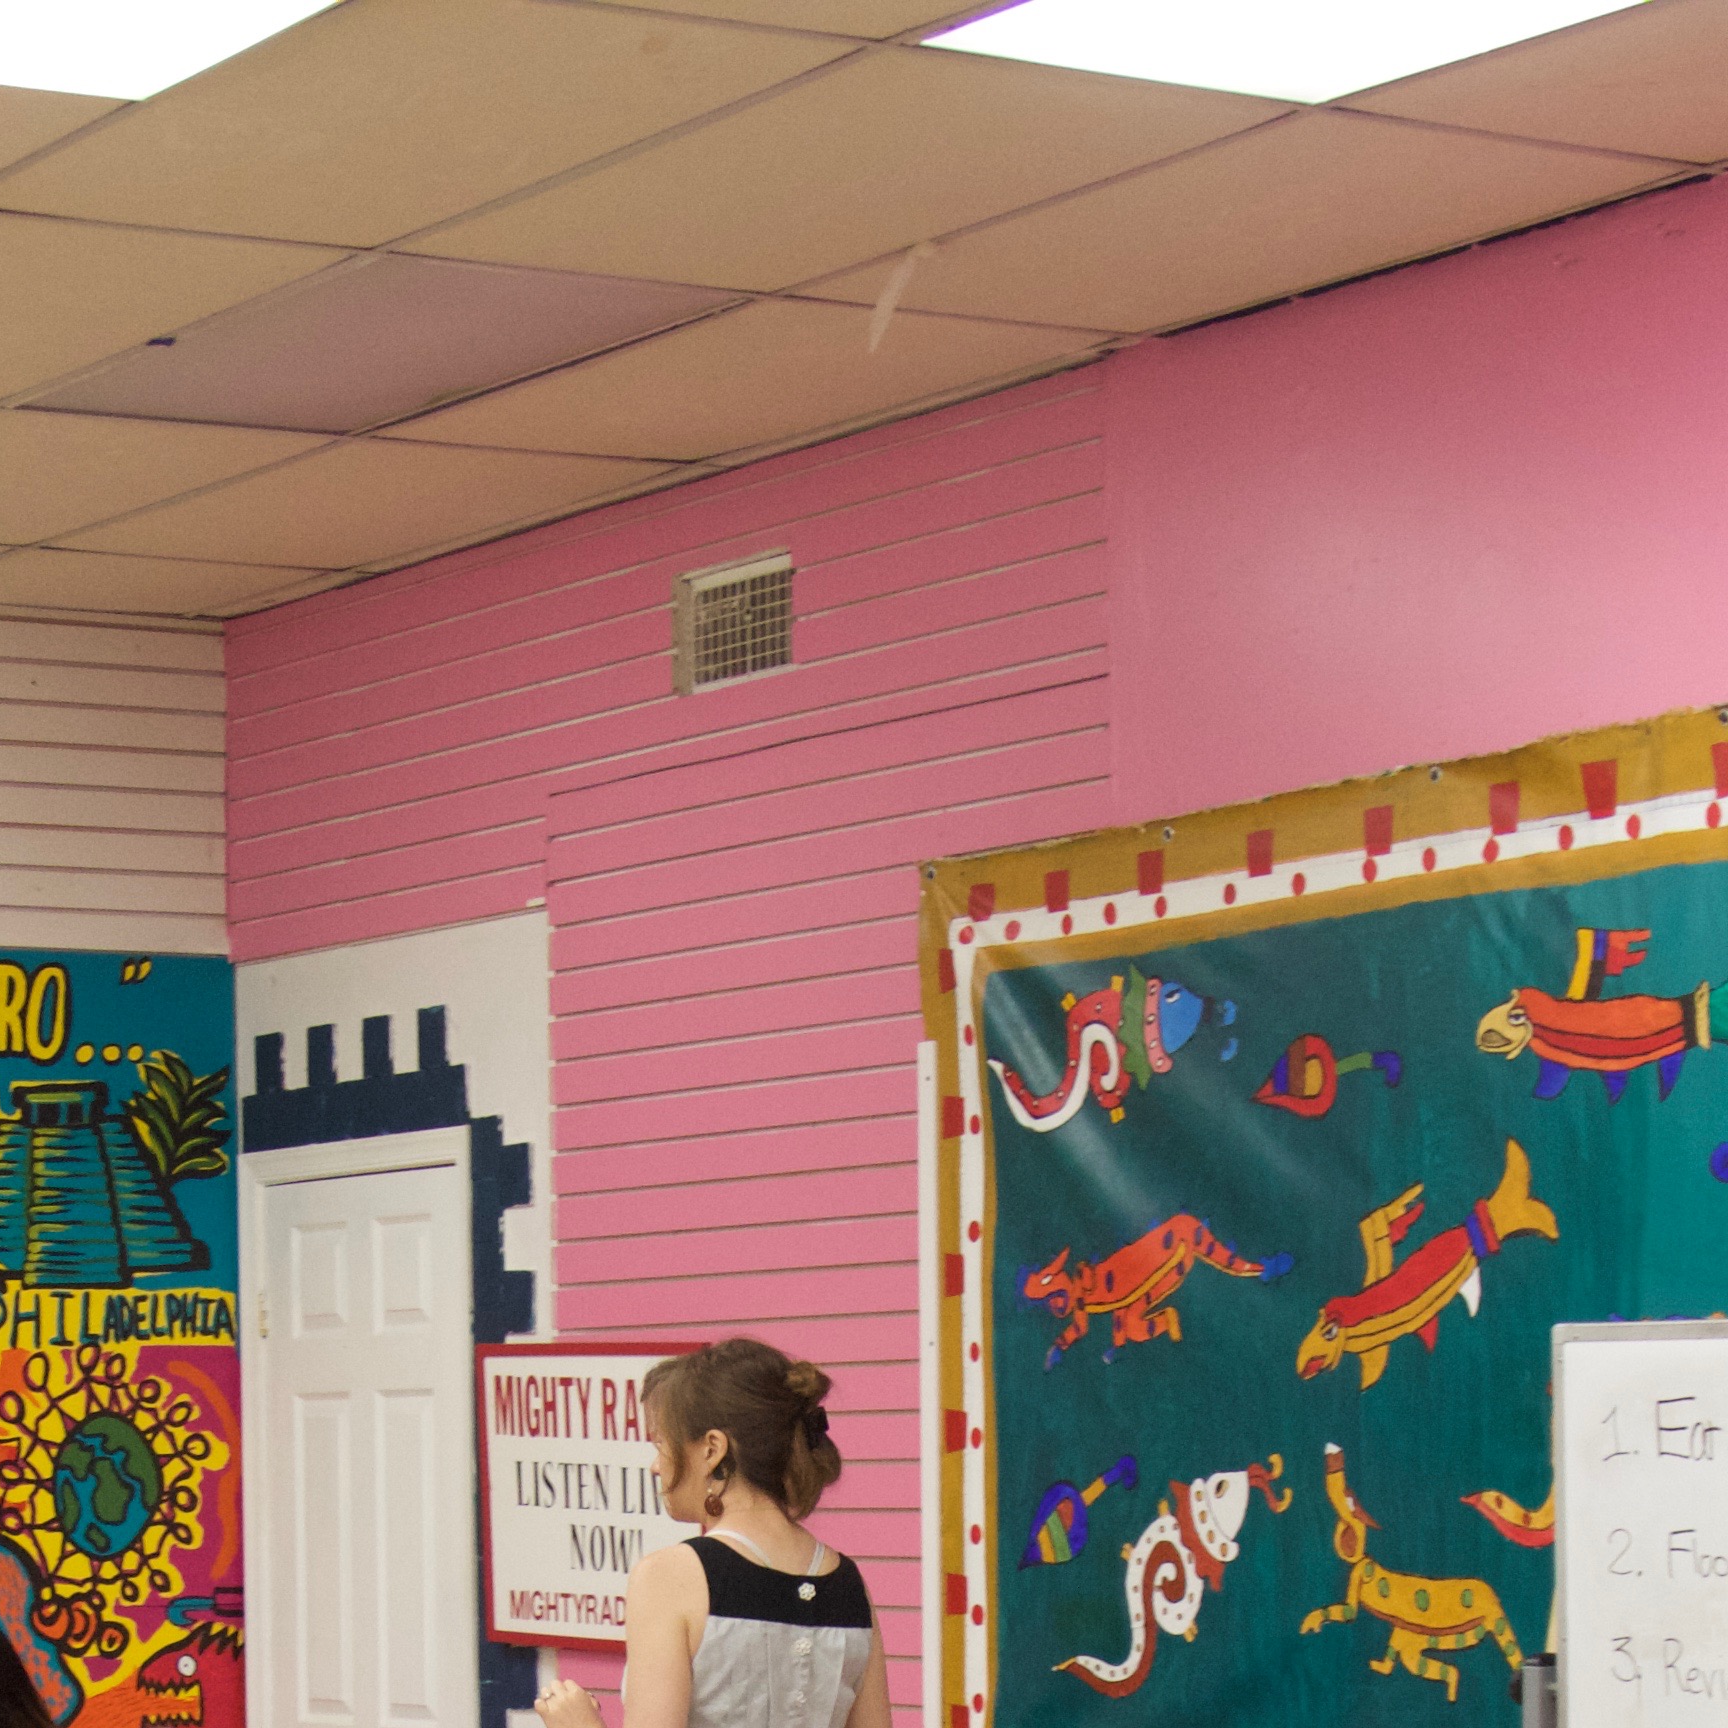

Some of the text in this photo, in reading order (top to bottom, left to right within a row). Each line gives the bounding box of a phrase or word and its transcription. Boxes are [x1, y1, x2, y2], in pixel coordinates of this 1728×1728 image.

[494, 1375, 651, 1442] MIGHTY RA
[1601, 1406, 1639, 1462] 1.
[1656, 1396, 1722, 1462] Eat
[515, 1460, 609, 1512] LISTEN
[1606, 1528, 1643, 1576] 2.
